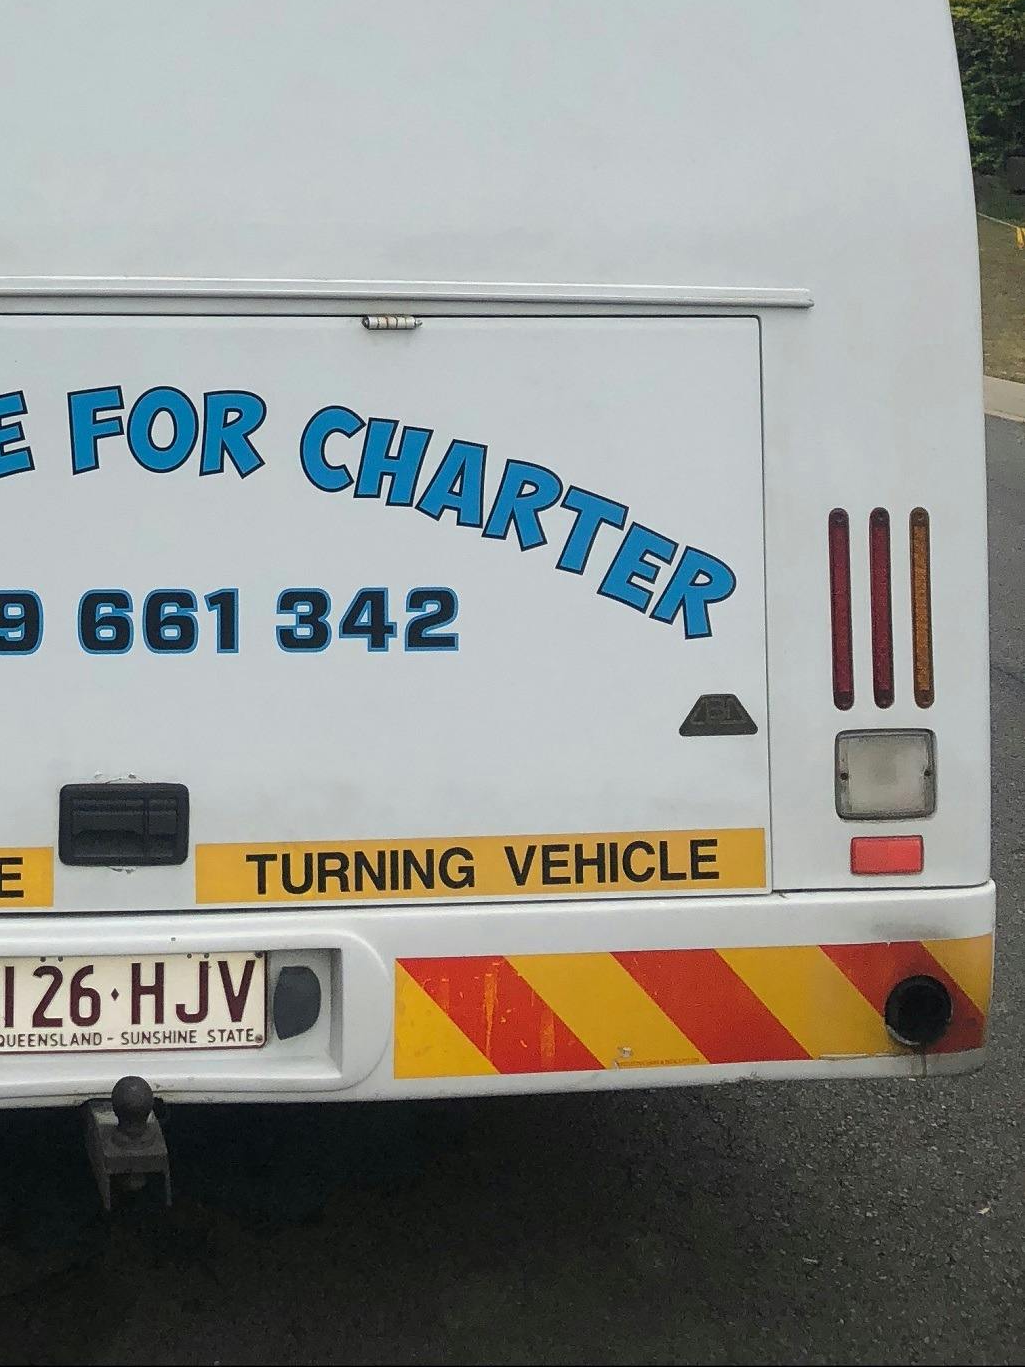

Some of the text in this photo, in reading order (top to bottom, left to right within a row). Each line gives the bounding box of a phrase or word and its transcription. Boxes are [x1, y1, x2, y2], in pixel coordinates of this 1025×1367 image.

[66, 385, 268, 479] FOR
[299, 405, 738, 640] CHARTER
[77, 587, 240, 655] 661
[275, 586, 461, 653] 342
[245, 838, 720, 895] TURNING VEHICLE
[120, 1029, 198, 1044] SUNSHINE
[206, 1028, 255, 1043] STATE
